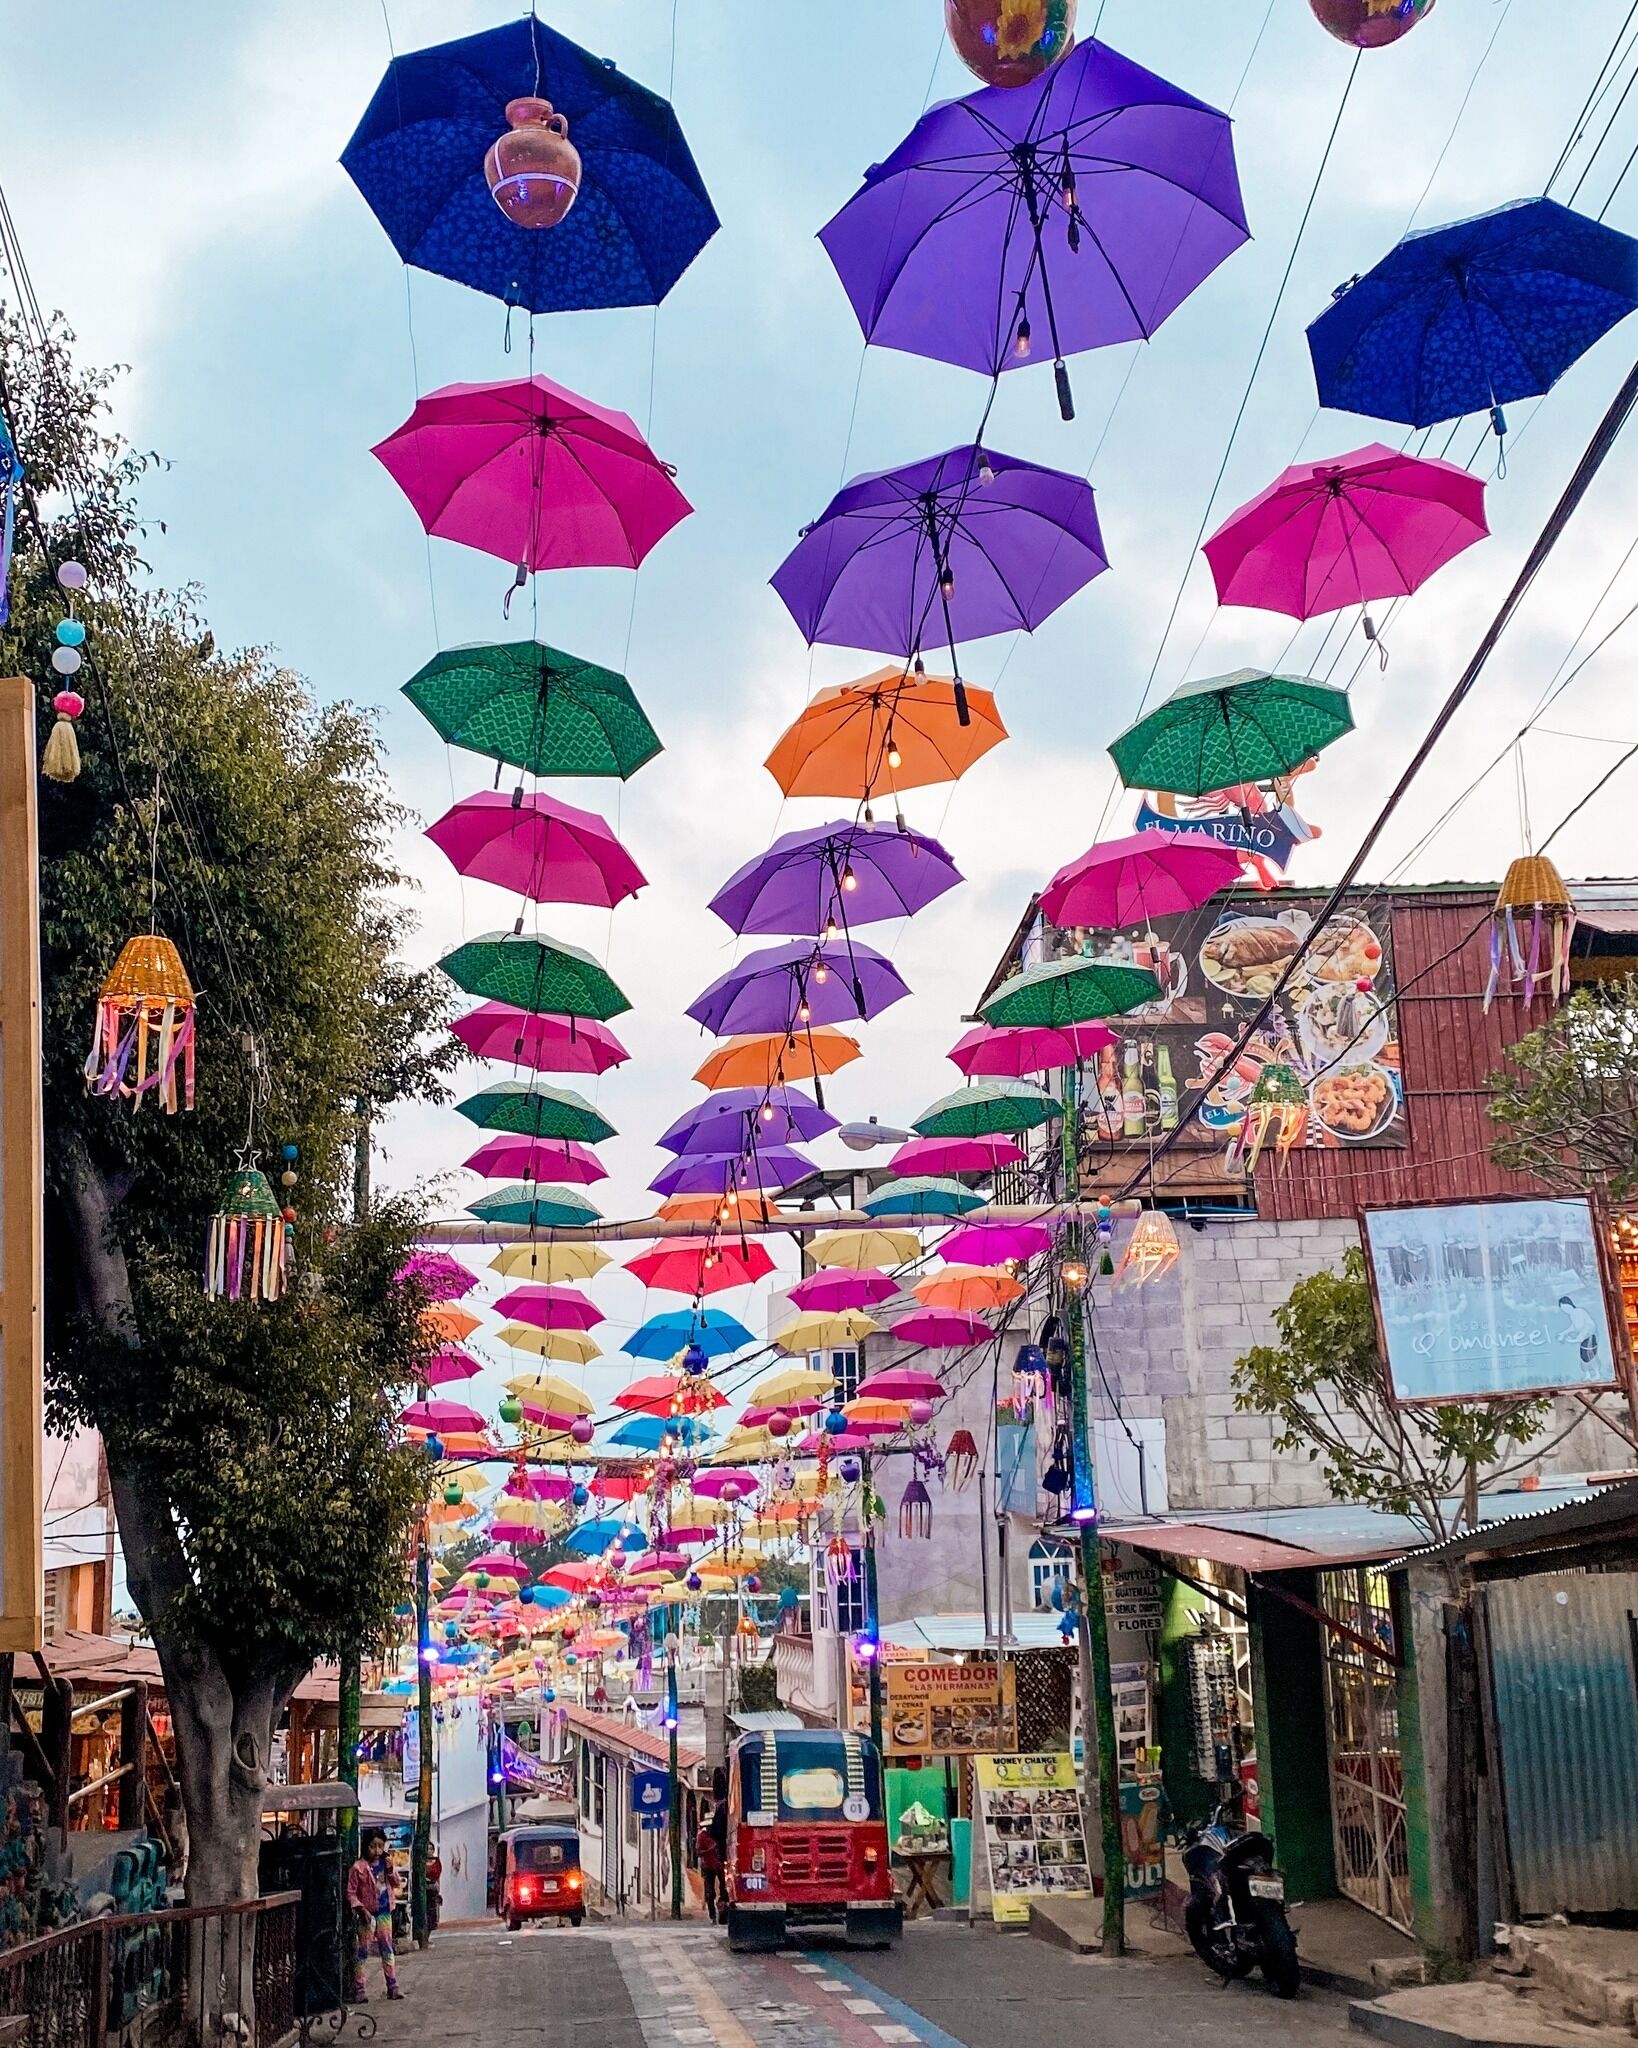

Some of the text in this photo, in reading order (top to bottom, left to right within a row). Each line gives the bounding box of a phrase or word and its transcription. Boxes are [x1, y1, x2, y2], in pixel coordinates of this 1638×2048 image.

[1113, 1569, 1157, 1581] SHUTTLES
[1115, 1585, 1158, 1598] GUATEMALA
[1118, 1618, 1161, 1631] FLORES
[903, 1667, 998, 1682] COMEDOR
[992, 1757, 1022, 1765] MONEY
[850, 1803, 862, 1813] 01
[746, 1878, 763, 1889] 001
